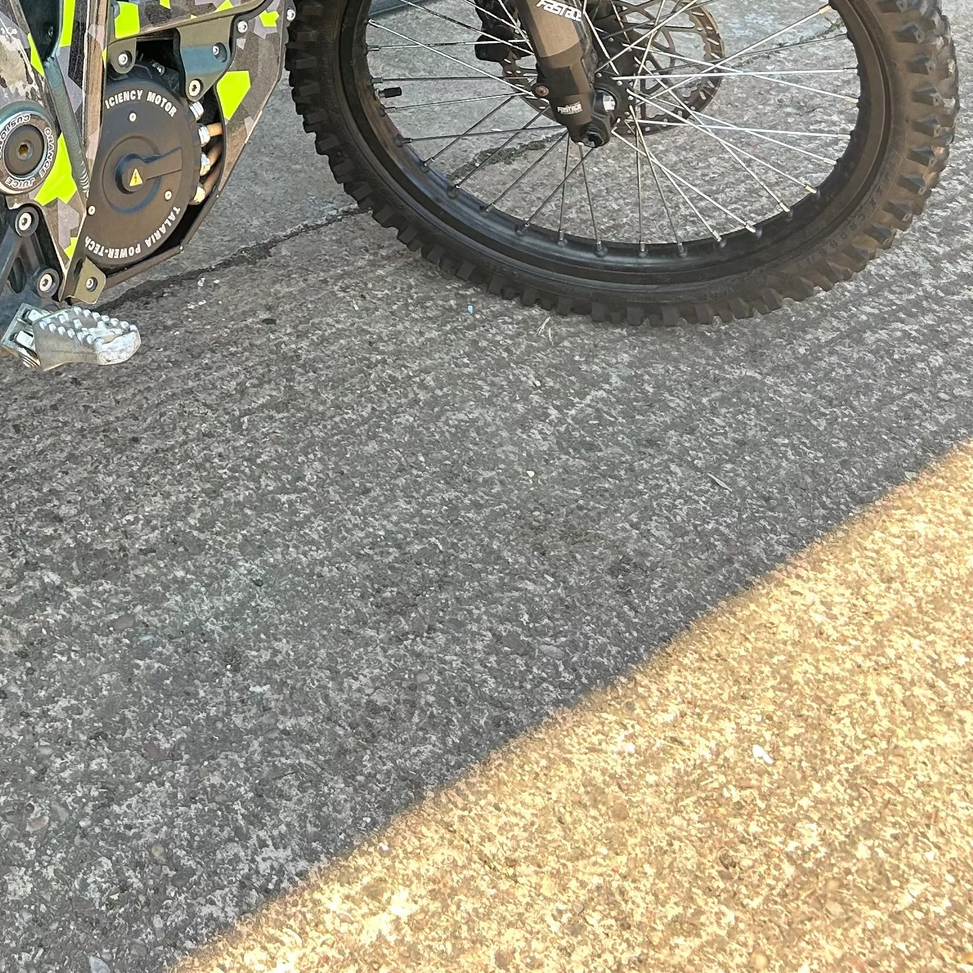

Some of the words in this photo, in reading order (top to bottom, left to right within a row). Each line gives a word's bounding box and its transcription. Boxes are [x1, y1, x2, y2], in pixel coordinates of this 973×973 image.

[146, 90, 178, 118] MOTOR
[39, 127, 55, 179] ORANGE
[5, 176, 36, 189] JUICE
[144, 205, 182, 249] TALARIA
